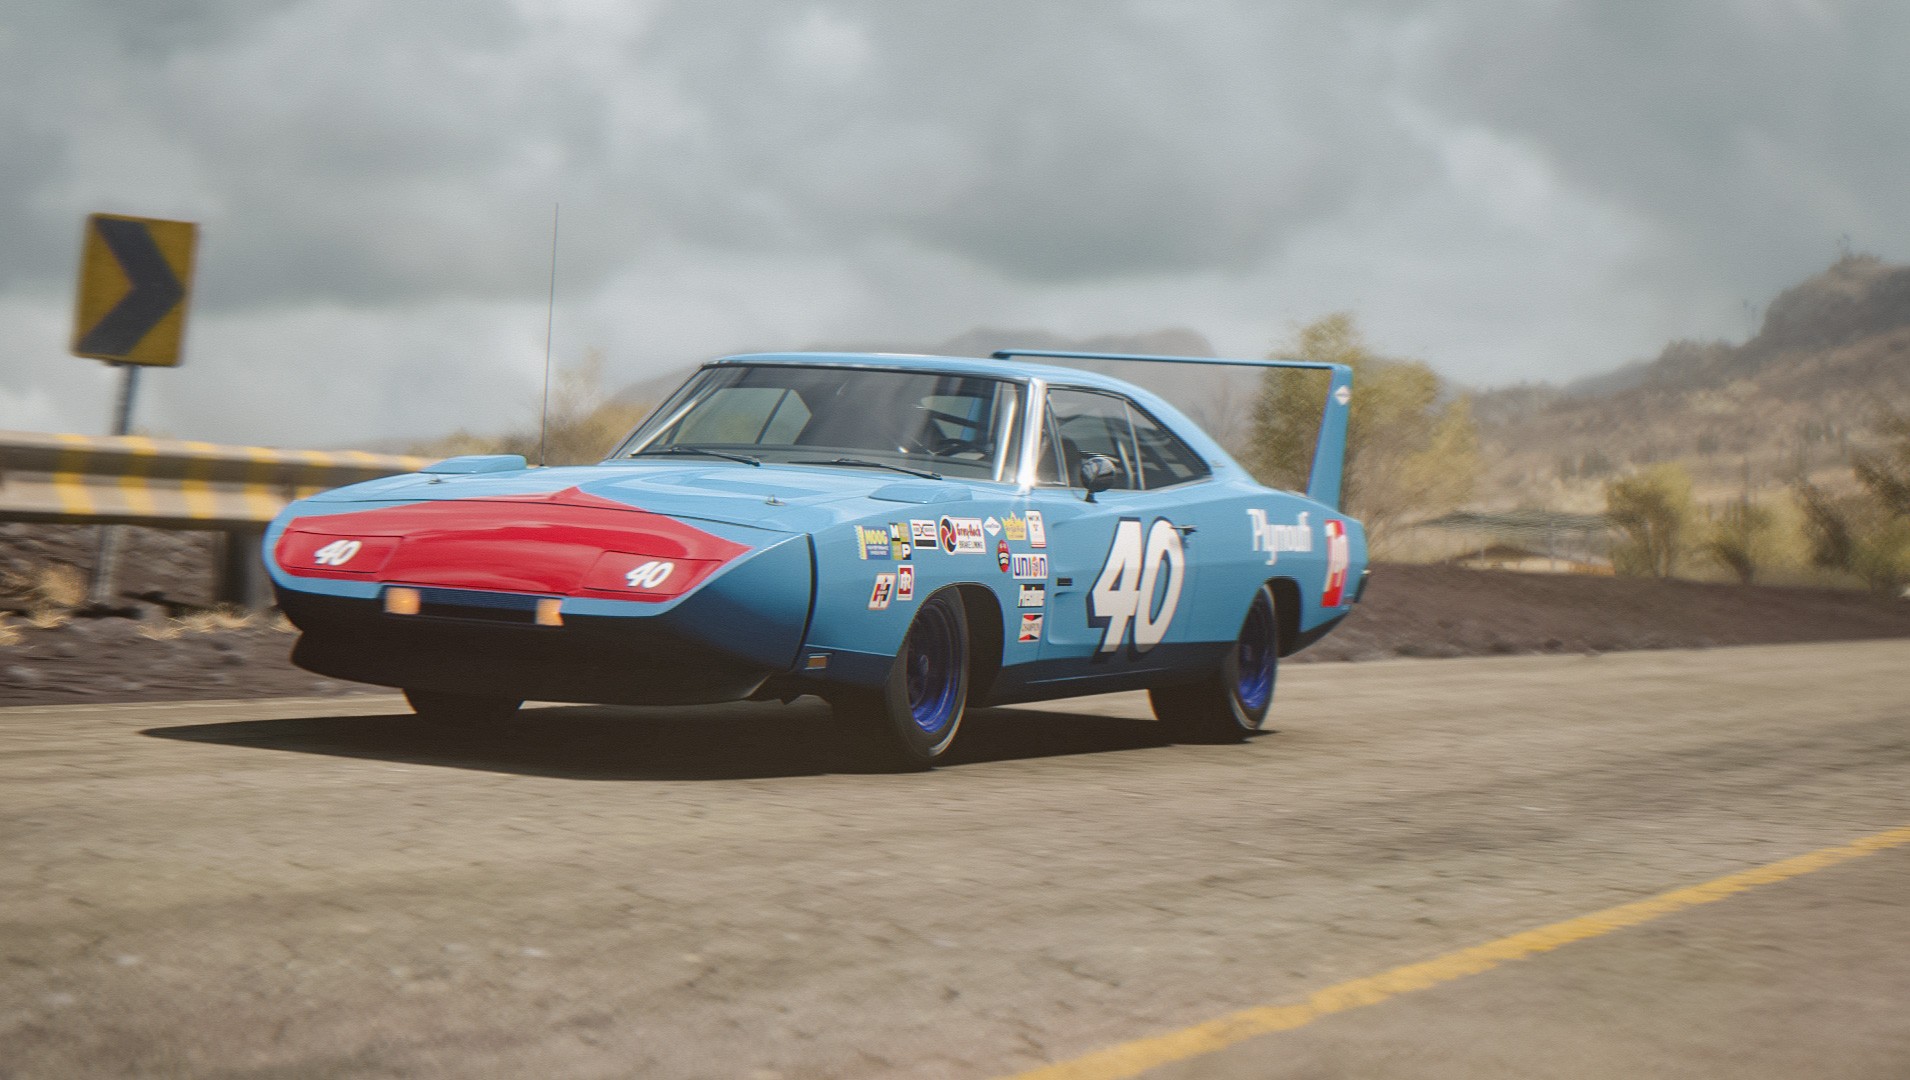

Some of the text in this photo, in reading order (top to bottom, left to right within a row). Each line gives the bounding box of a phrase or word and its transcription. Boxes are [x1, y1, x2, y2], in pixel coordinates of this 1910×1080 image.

[313, 539, 362, 566] 40
[1246, 508, 1312, 566] Plymouth
[625, 561, 675, 589] 40
[1088, 517, 1185, 656] 40
